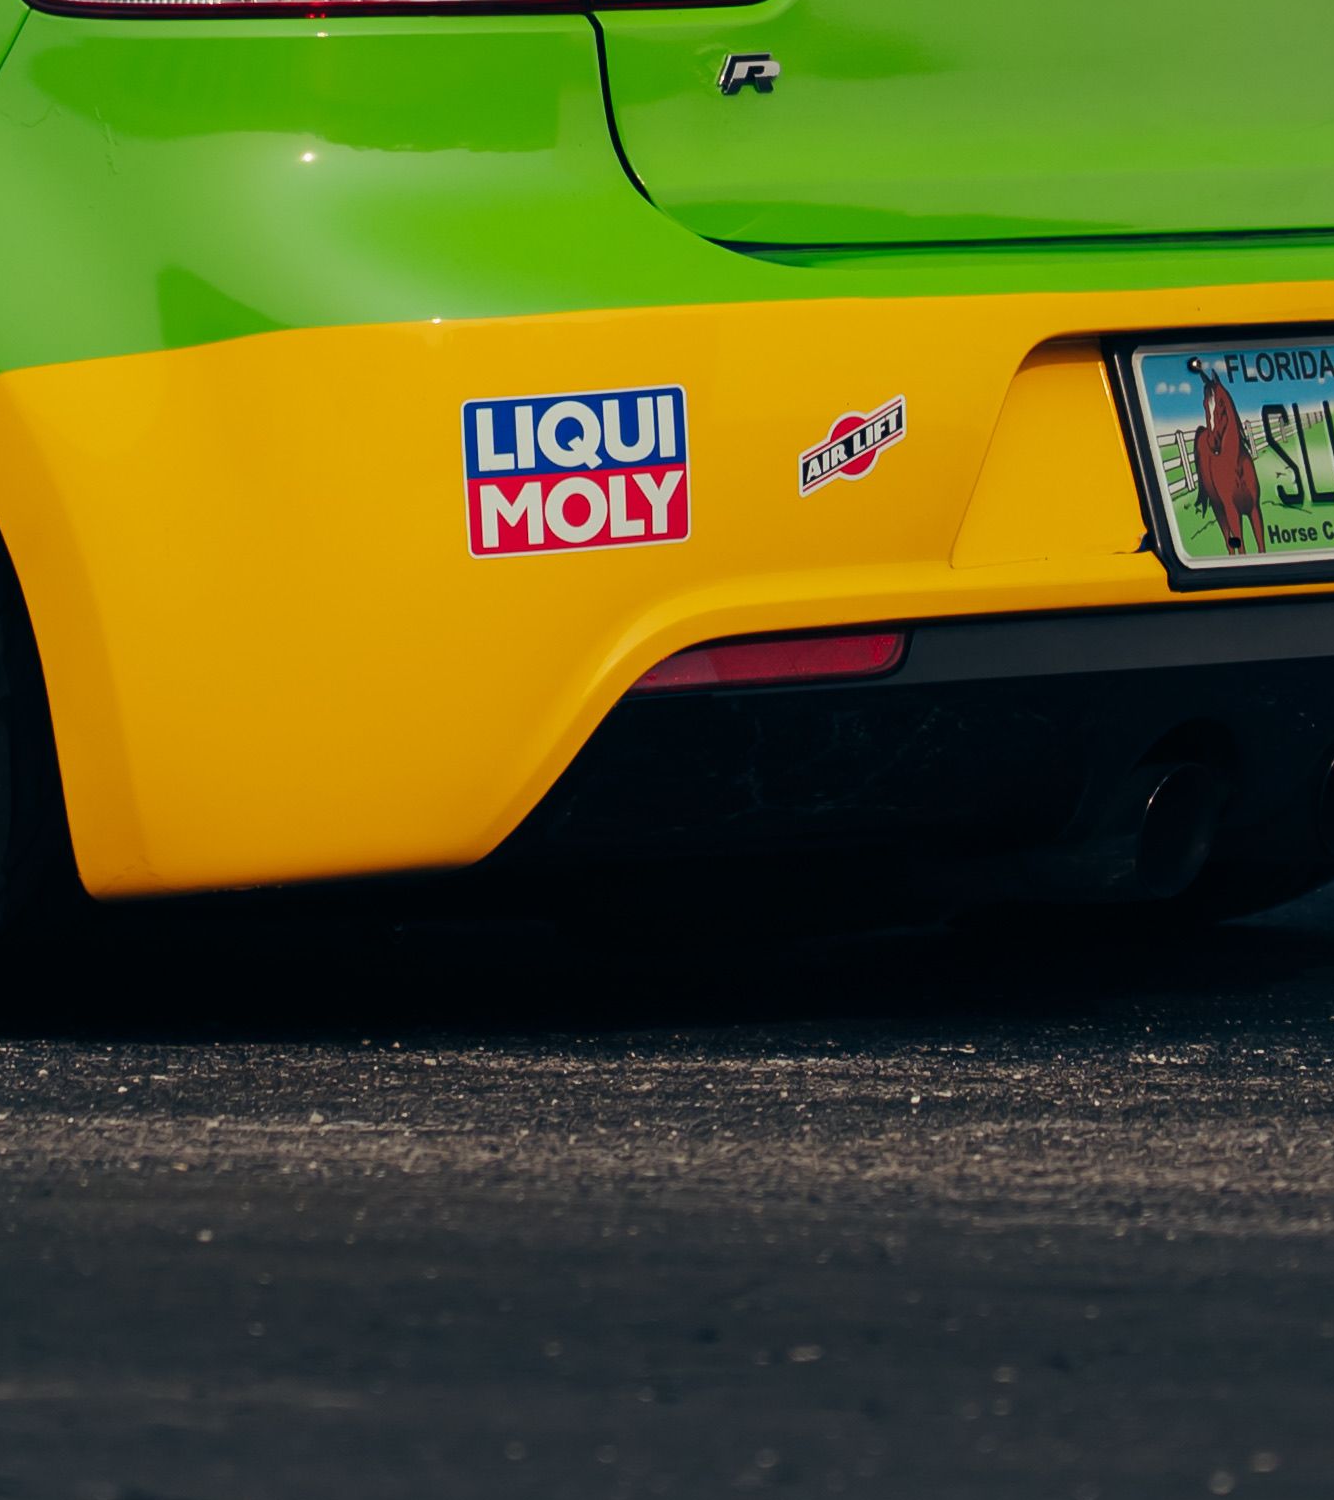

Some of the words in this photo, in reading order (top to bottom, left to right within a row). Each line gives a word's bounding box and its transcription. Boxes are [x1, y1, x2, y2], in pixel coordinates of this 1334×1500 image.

[718, 53, 780, 95] R
[476, 395, 676, 472] LIQUI
[807, 443, 847, 481] AIR
[853, 409, 899, 454] LIFT
[479, 471, 683, 549] MOLY
[1268, 523, 1317, 544] Horse
